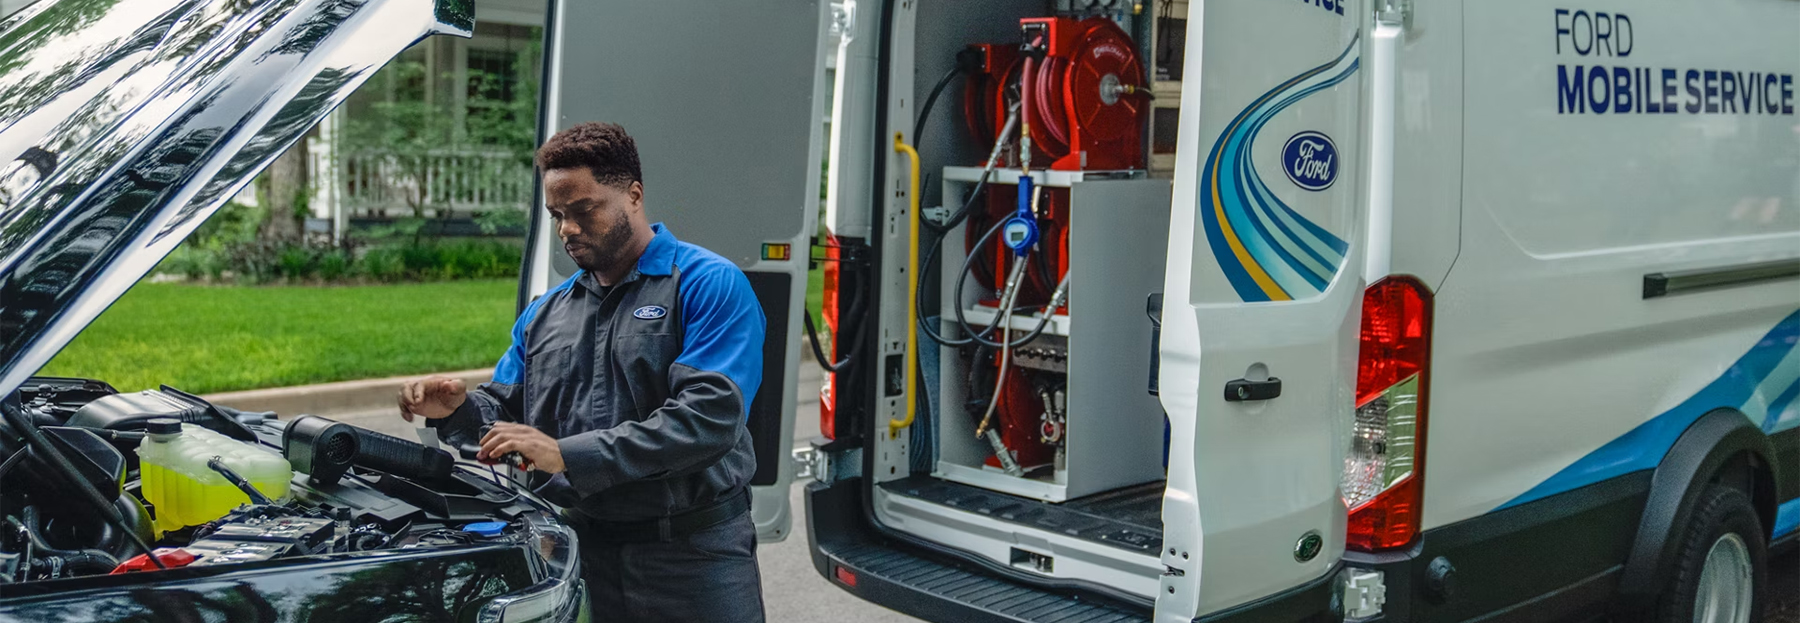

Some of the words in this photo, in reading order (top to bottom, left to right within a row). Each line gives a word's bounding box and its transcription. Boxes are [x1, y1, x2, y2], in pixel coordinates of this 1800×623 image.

[1555, 8, 1633, 57] FORD
[1557, 64, 1679, 114] MOBILE
[1684, 68, 1794, 115] SERVICE
[1294, 139, 1332, 181] Ford
